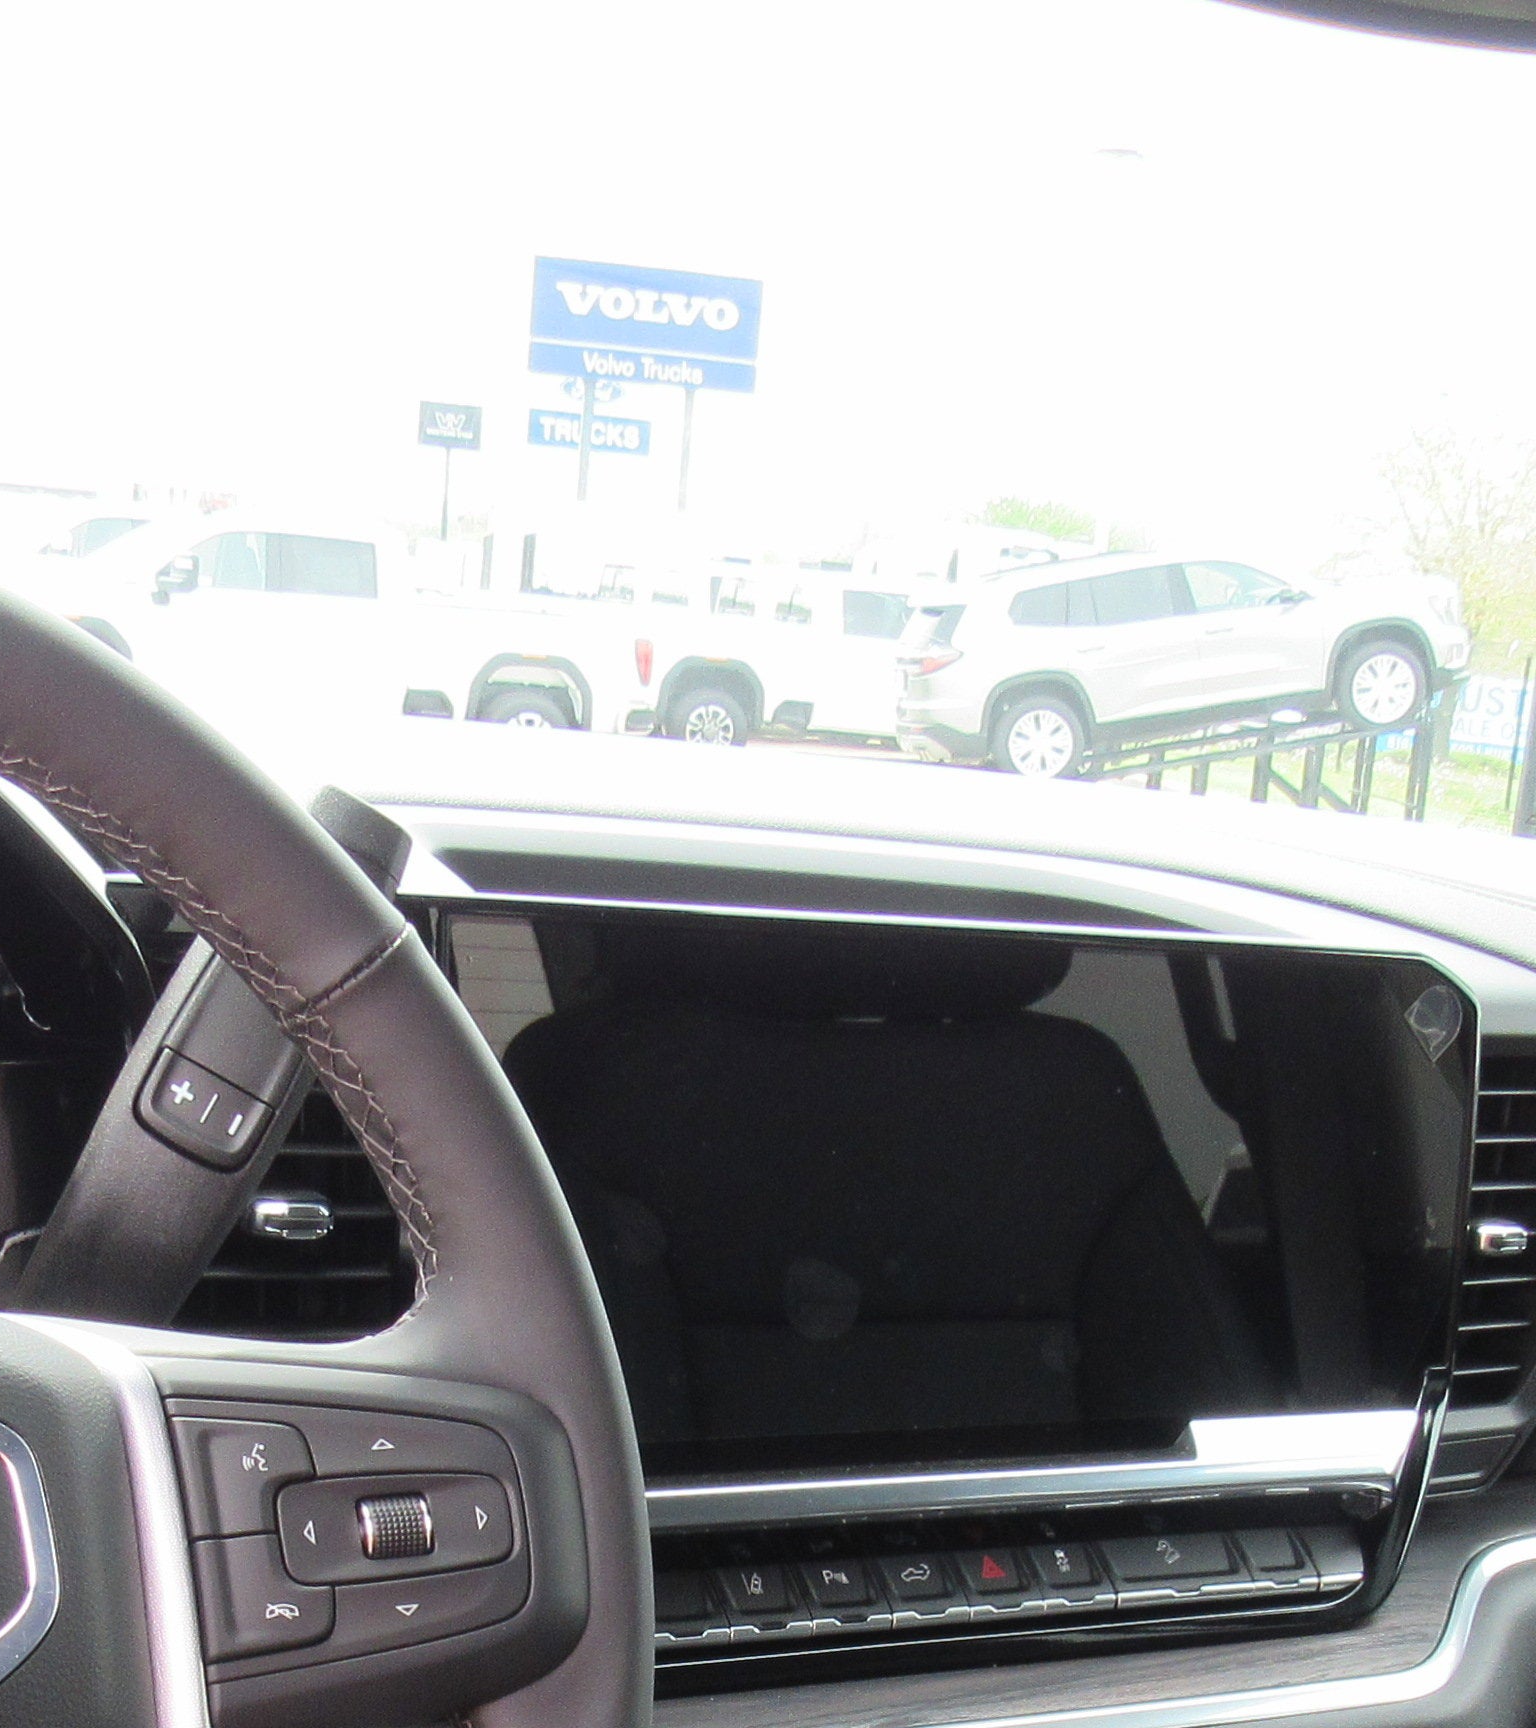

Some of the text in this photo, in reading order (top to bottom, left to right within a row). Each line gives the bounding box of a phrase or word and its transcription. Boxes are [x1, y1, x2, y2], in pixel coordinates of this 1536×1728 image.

[556, 282, 740, 331] VOLVO
[582, 350, 704, 385] Volvo Trucks
